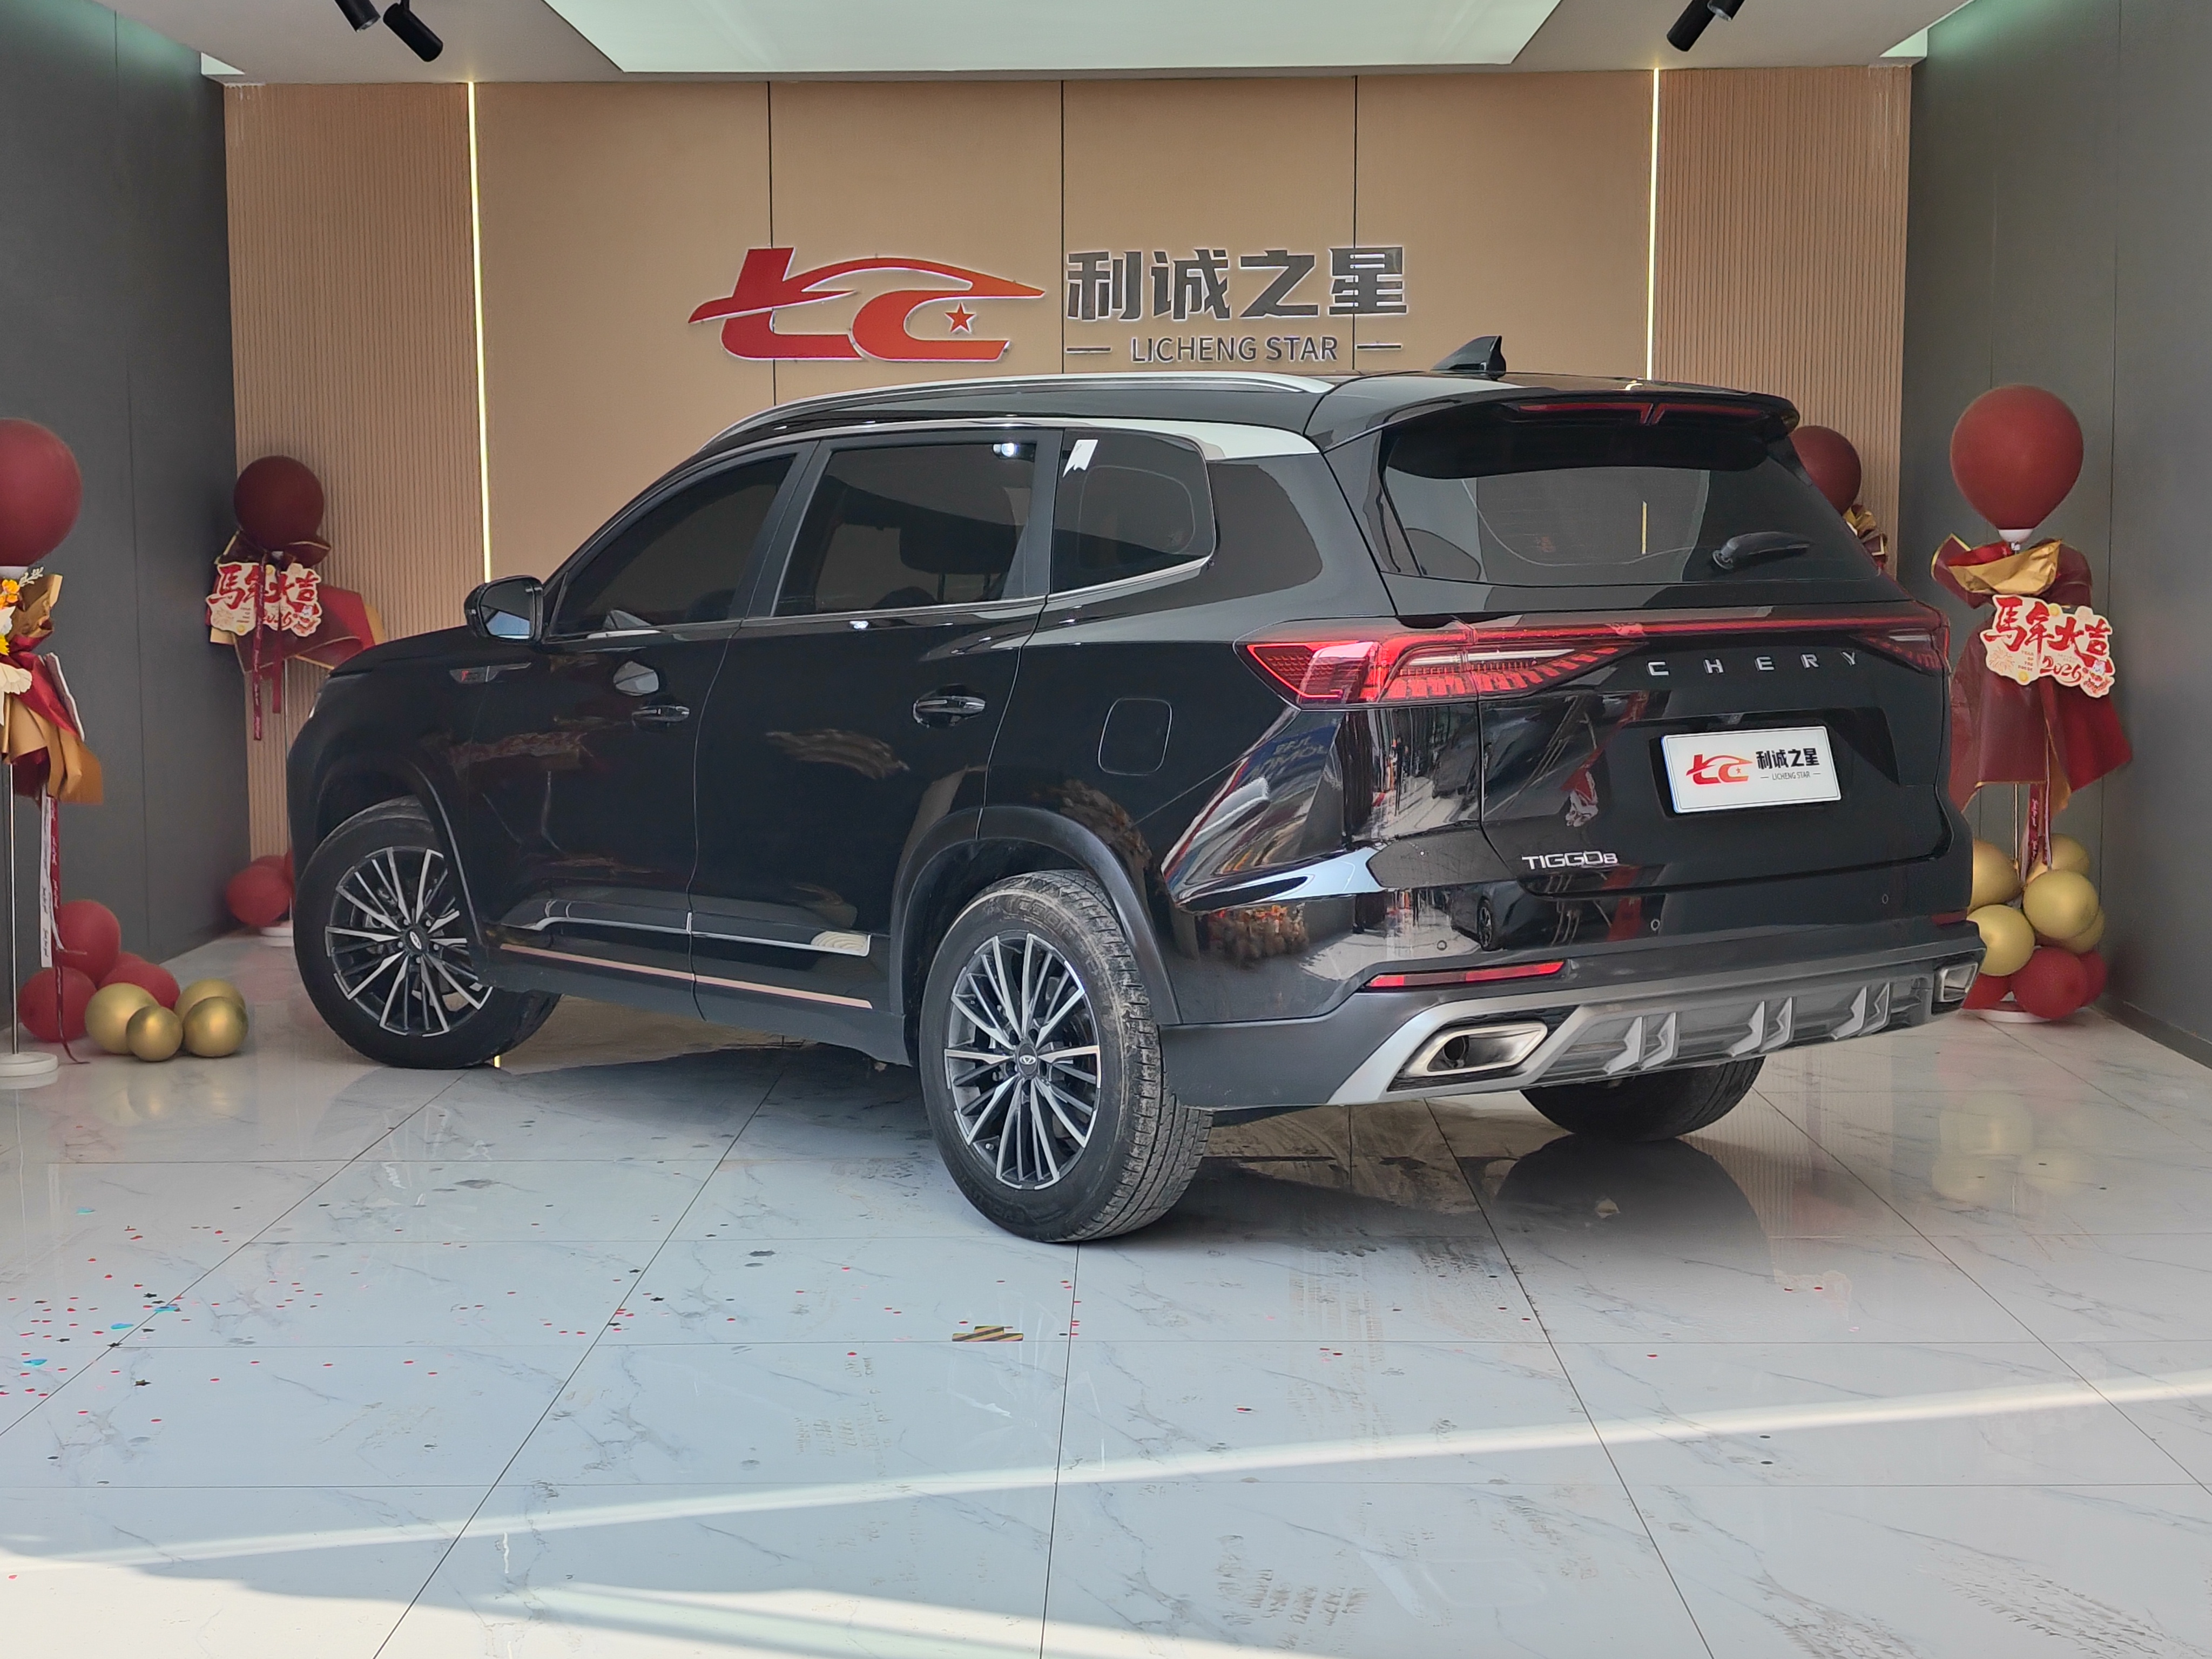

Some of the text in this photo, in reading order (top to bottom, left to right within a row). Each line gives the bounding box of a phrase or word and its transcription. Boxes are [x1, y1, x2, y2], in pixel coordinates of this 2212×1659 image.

[1067, 247, 1407, 320] 利诚之星
[1132, 336, 1338, 362] LICHENG STAR
[1647, 651, 1856, 676] CHERY
[2040, 655, 2082, 683] 2026
[1756, 747, 1820, 770] 利诚之星
[1772, 772, 1796, 780] LICHENG
